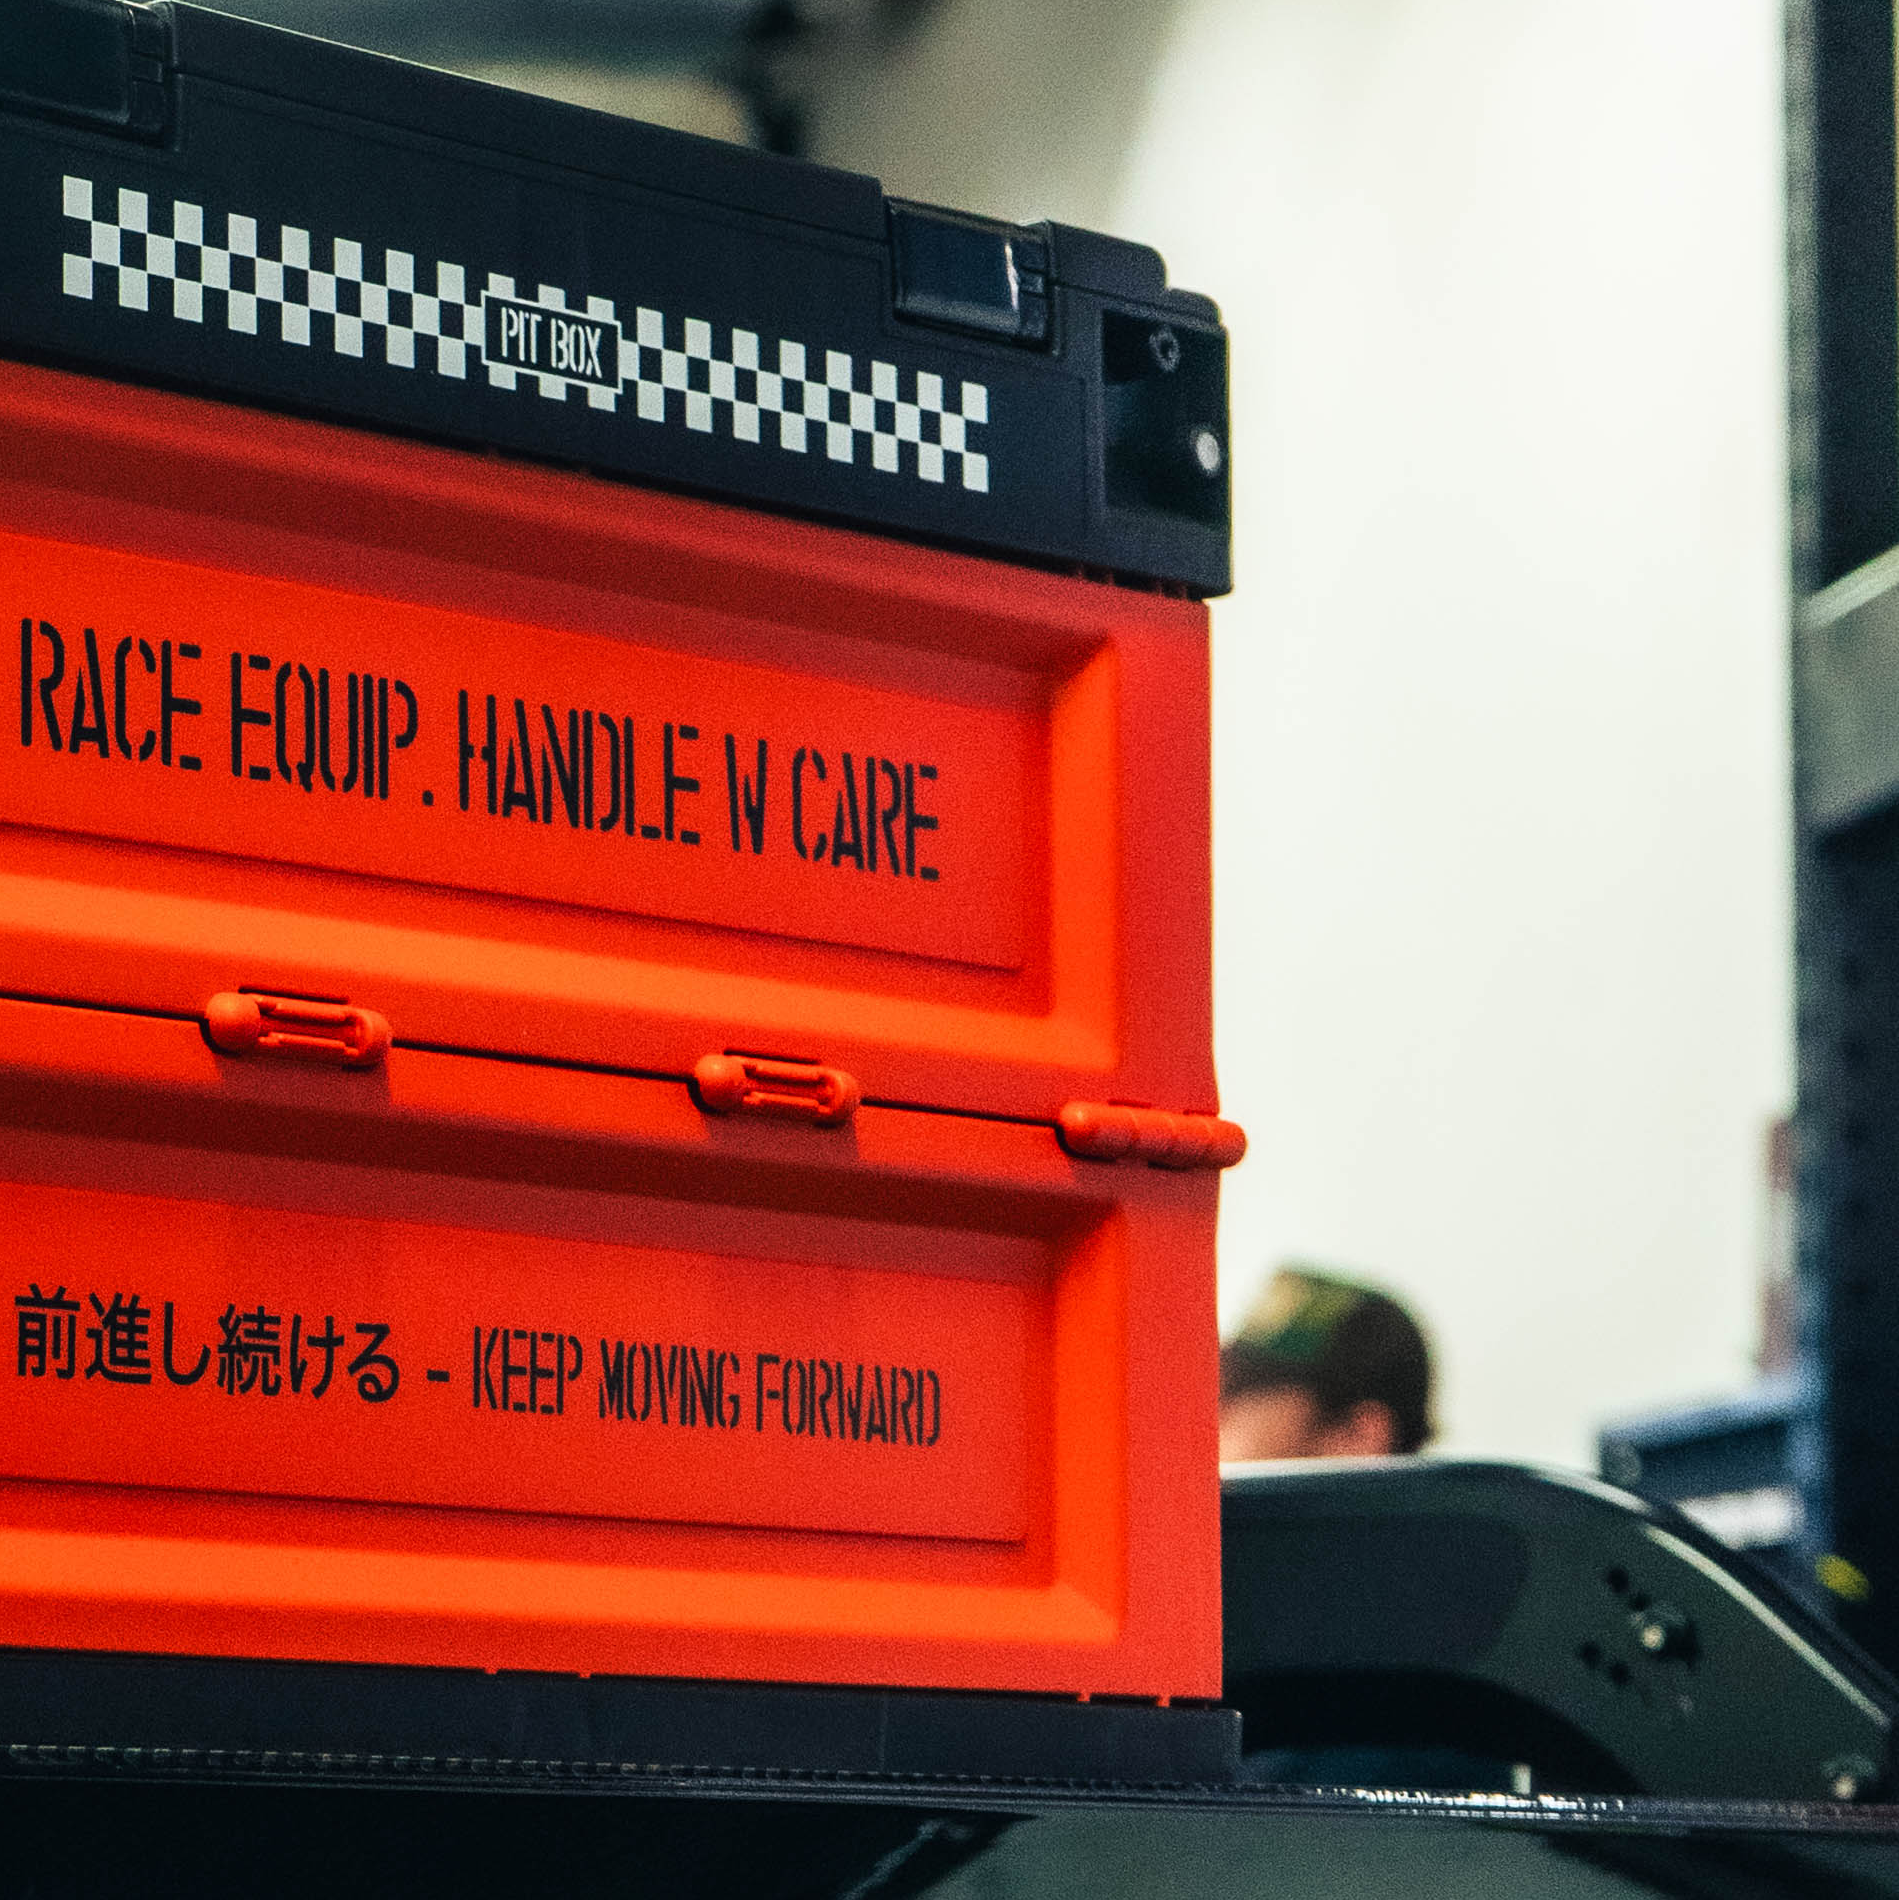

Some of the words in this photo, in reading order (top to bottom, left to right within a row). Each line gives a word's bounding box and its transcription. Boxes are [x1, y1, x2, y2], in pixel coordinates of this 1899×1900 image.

[501, 306, 542, 364] PIT
[550, 317, 602, 379] BOX
[20, 617, 202, 771] RACE
[458, 689, 700, 845] HANDLE
[725, 734, 767, 855] W
[791, 747, 939, 881] CARE
[14, 1283, 401, 1403] 前進し続ける
[471, 1326, 583, 1416] KEEP
[599, 1337, 742, 1430] MOVING
[754, 1352, 942, 1447] FORWARD
